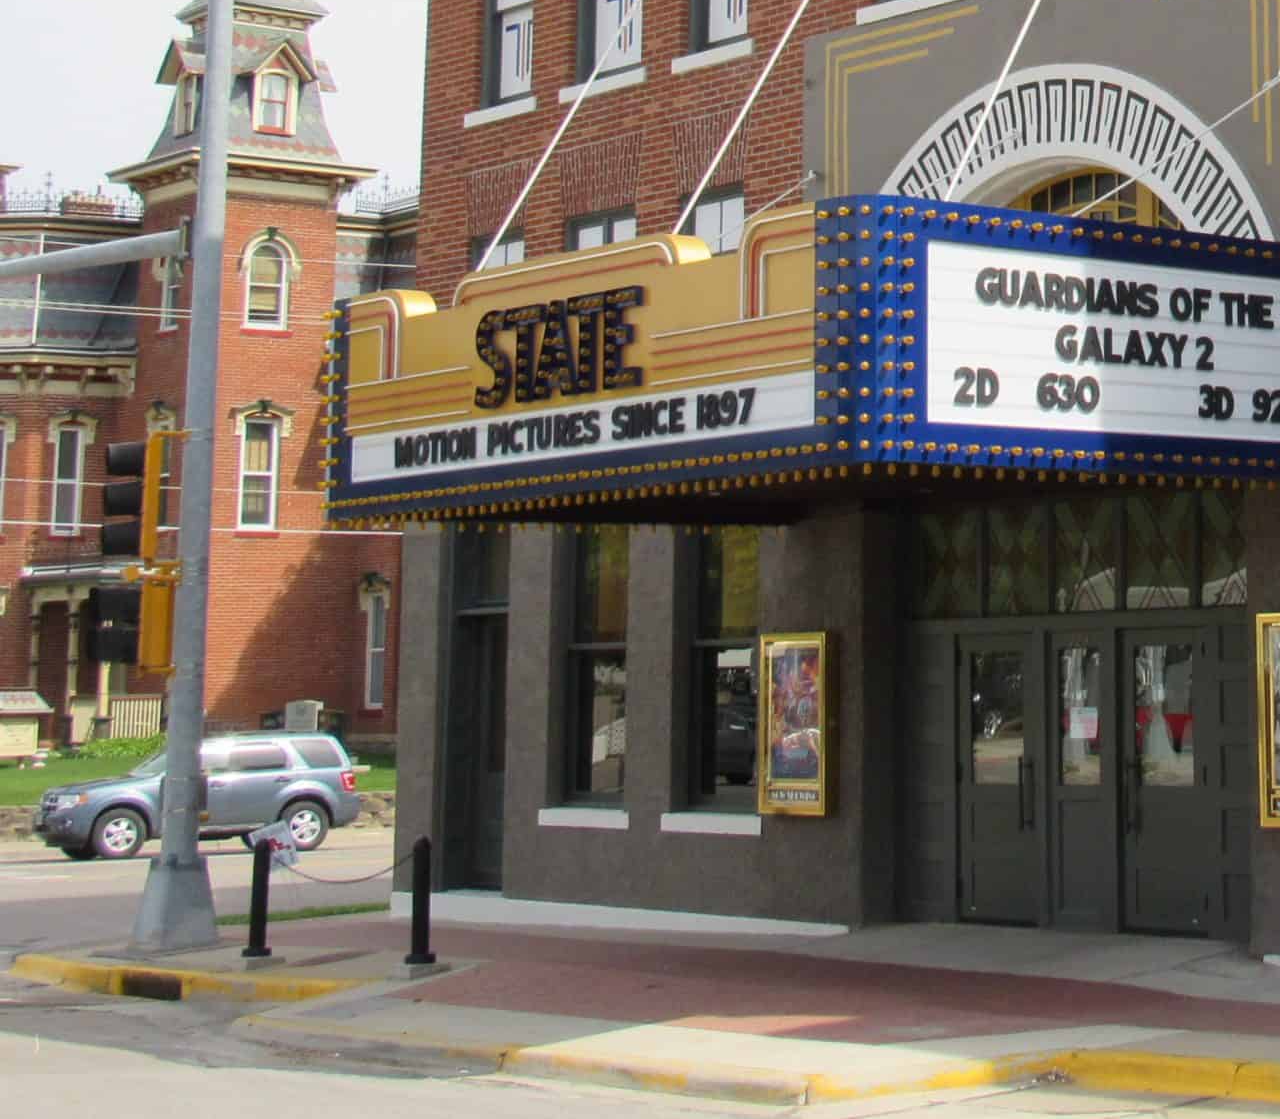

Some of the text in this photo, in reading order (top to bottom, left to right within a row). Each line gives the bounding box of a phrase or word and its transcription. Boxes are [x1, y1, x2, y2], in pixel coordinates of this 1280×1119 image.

[975, 266, 1276, 331] GUARDIANS OF THE
[474, 285, 645, 409] STATE
[1055, 325, 1215, 372] GALAXY 2
[953, 366, 1000, 406] 2D
[1036, 372, 1101, 413] 630
[1198, 383, 1235, 423] 3D
[394, 387, 757, 469] MOTION PICTURES SINCE 1897
